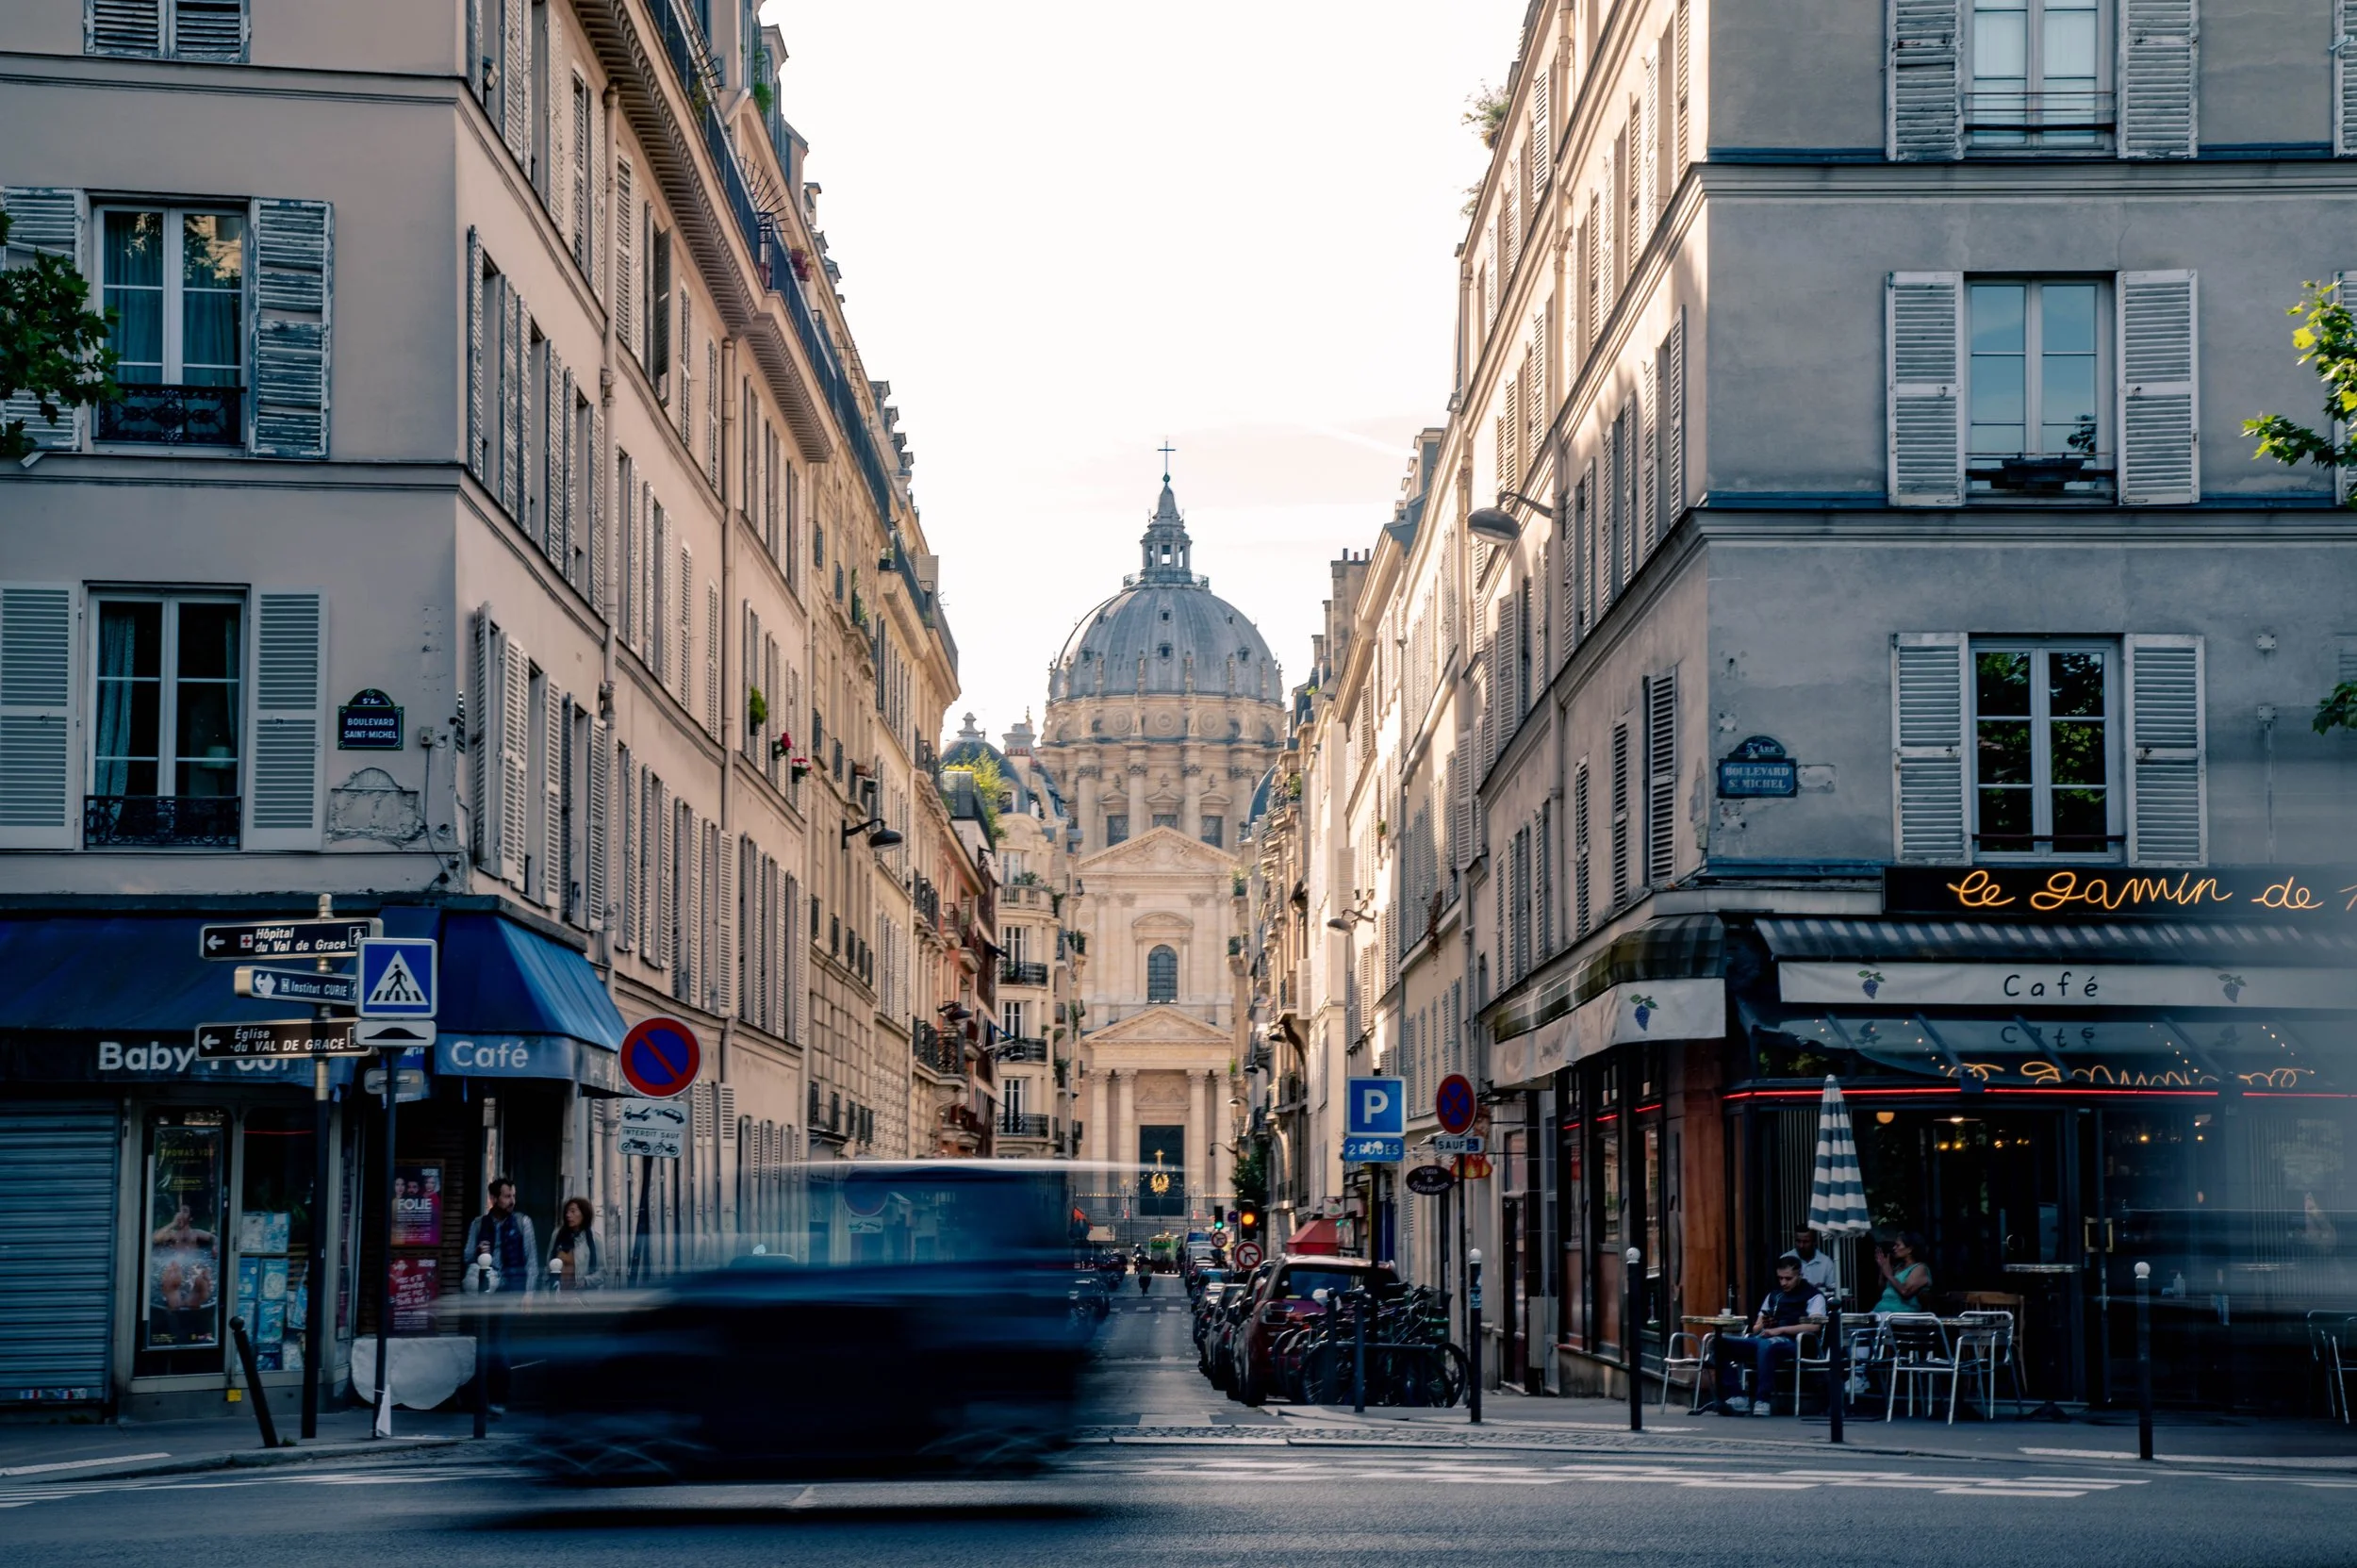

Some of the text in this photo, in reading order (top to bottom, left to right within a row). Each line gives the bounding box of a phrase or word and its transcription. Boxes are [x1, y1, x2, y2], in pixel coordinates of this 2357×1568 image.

[347, 718, 395, 726] BOULEVARD
[344, 731, 397, 739] SAINT-MICHEL
[1724, 766, 1789, 776] BOULEVARD
[1741, 779, 1787, 789] MICHEL
[1946, 869, 2016, 907] le
[2029, 871, 2233, 911] gamin
[2250, 876, 2324, 910] de
[255, 927, 295, 940] Hôpital
[255, 939, 347, 953] du Val de Grace
[290, 980, 321, 995] Institut
[323, 984, 348, 998] CURIE
[2003, 971, 2099, 998] Café
[234, 1025, 271, 1042] Église
[234, 1037, 346, 1053] du VAL DE GRACE
[98, 1041, 195, 1072] Baby
[450, 1040, 529, 1068] Café
[1363, 1089, 1389, 1124] P
[622, 1128, 657, 1137] INTERDIT
[1348, 1144, 1357, 1155] 2
[1438, 1140, 1465, 1149] SAUF
[397, 1197, 433, 1210] FOLIE
